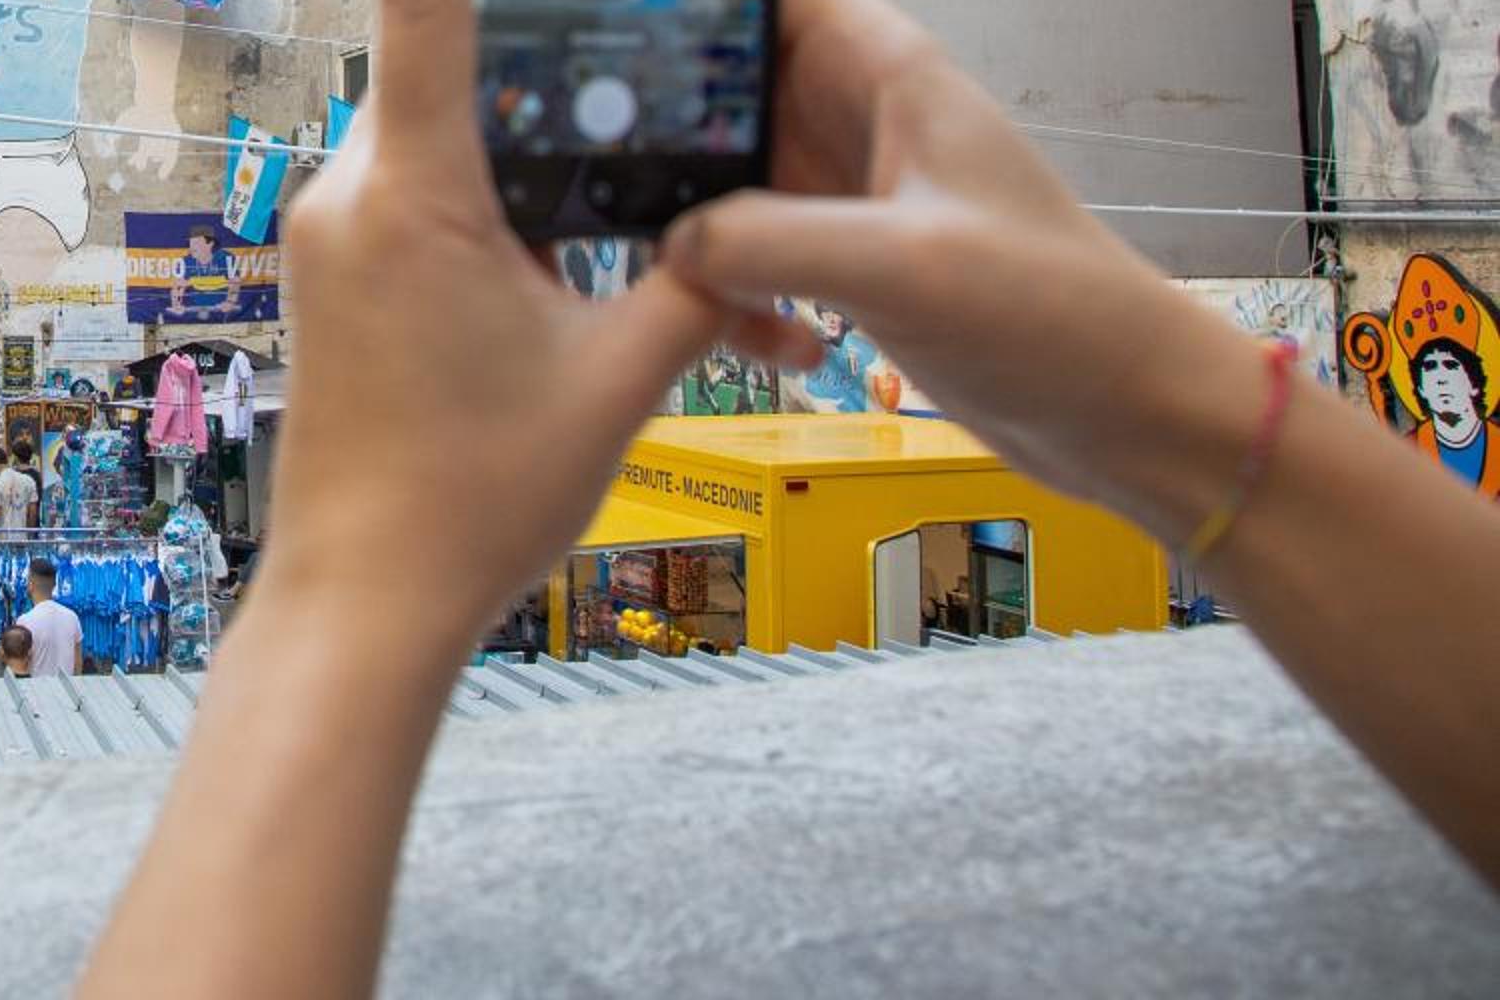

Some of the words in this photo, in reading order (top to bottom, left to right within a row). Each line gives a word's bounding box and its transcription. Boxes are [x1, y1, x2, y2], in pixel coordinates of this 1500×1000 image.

[128, 256, 185, 279] DIEGO
[225, 251, 279, 279] VIVE
[682, 475, 764, 516] MACEDONIE
